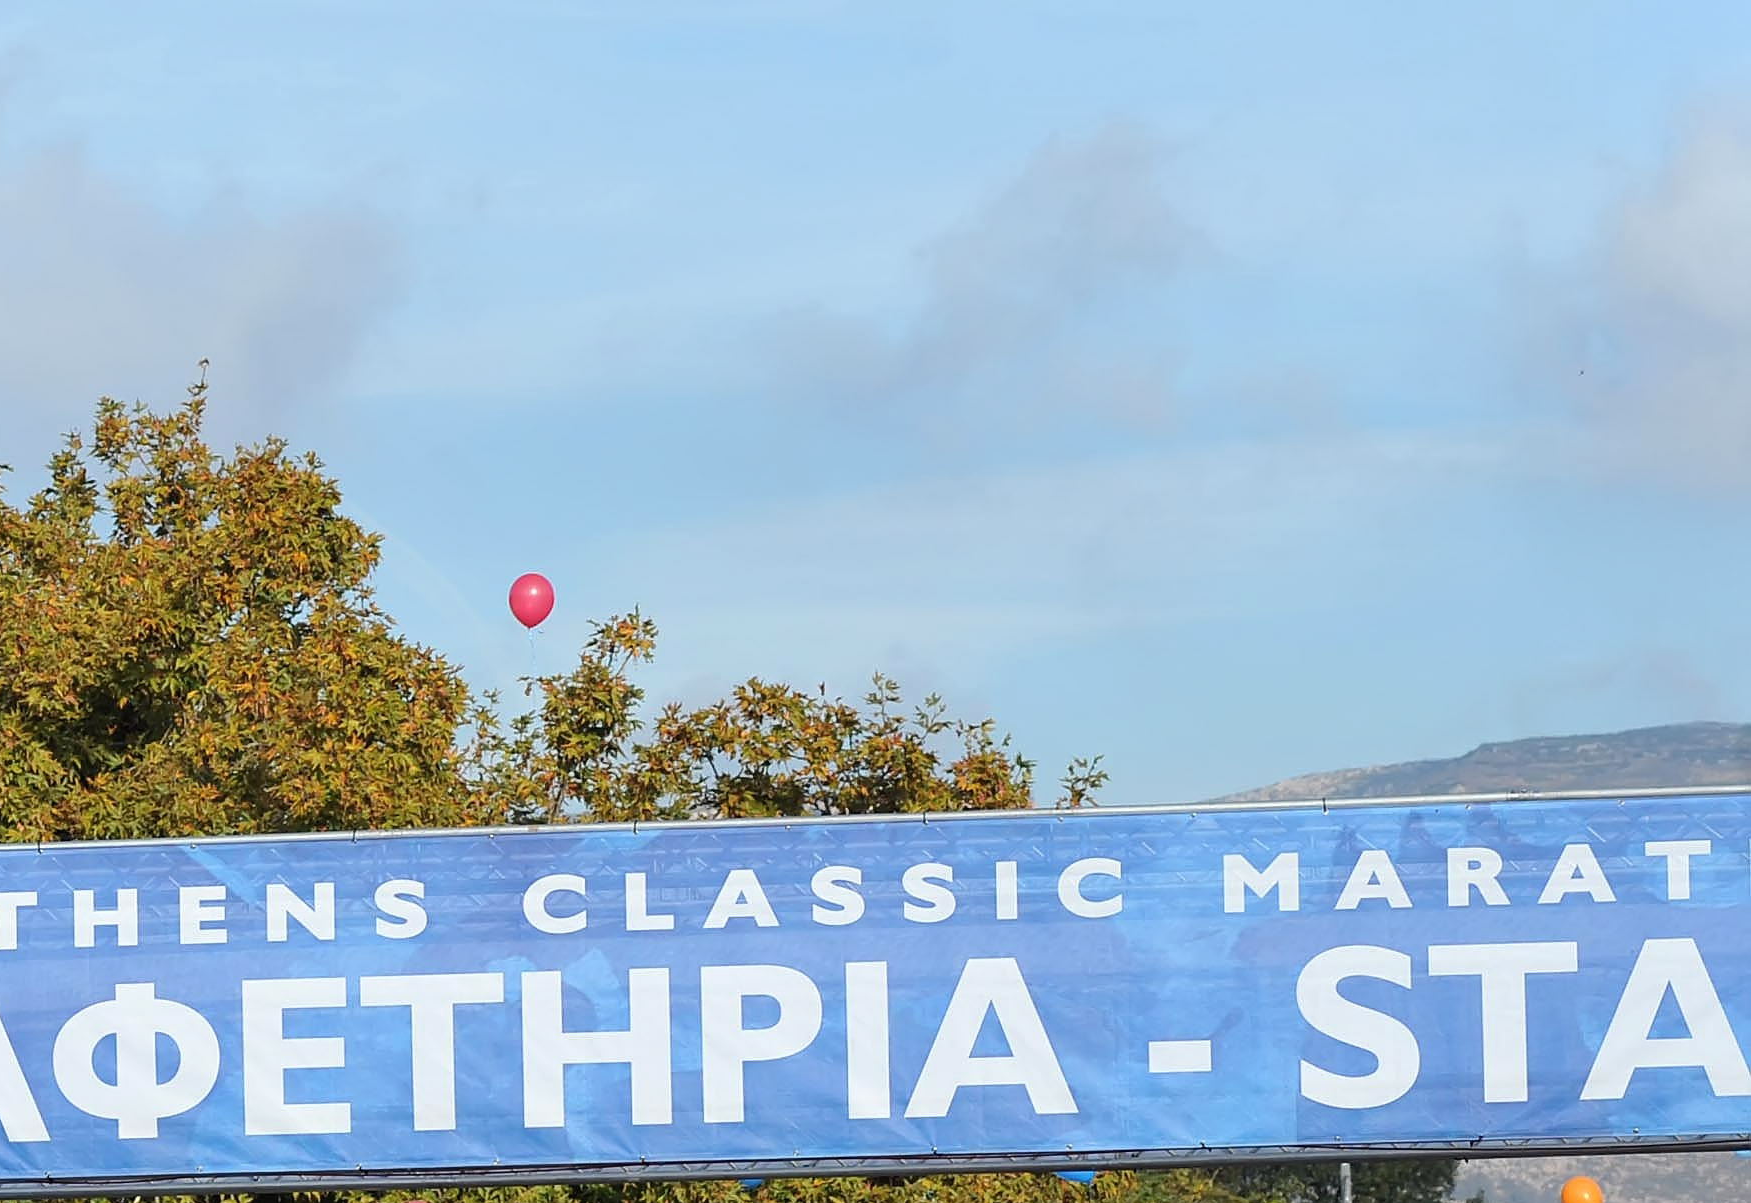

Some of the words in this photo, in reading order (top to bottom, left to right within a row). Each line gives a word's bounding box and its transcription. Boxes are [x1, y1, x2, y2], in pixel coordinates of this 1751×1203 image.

[522, 857, 1123, 933] CLASSIC
[1223, 840, 1711, 914] MARAT
[1148, 1039, 1213, 1073] -
[1295, 937, 1751, 1109] STA
